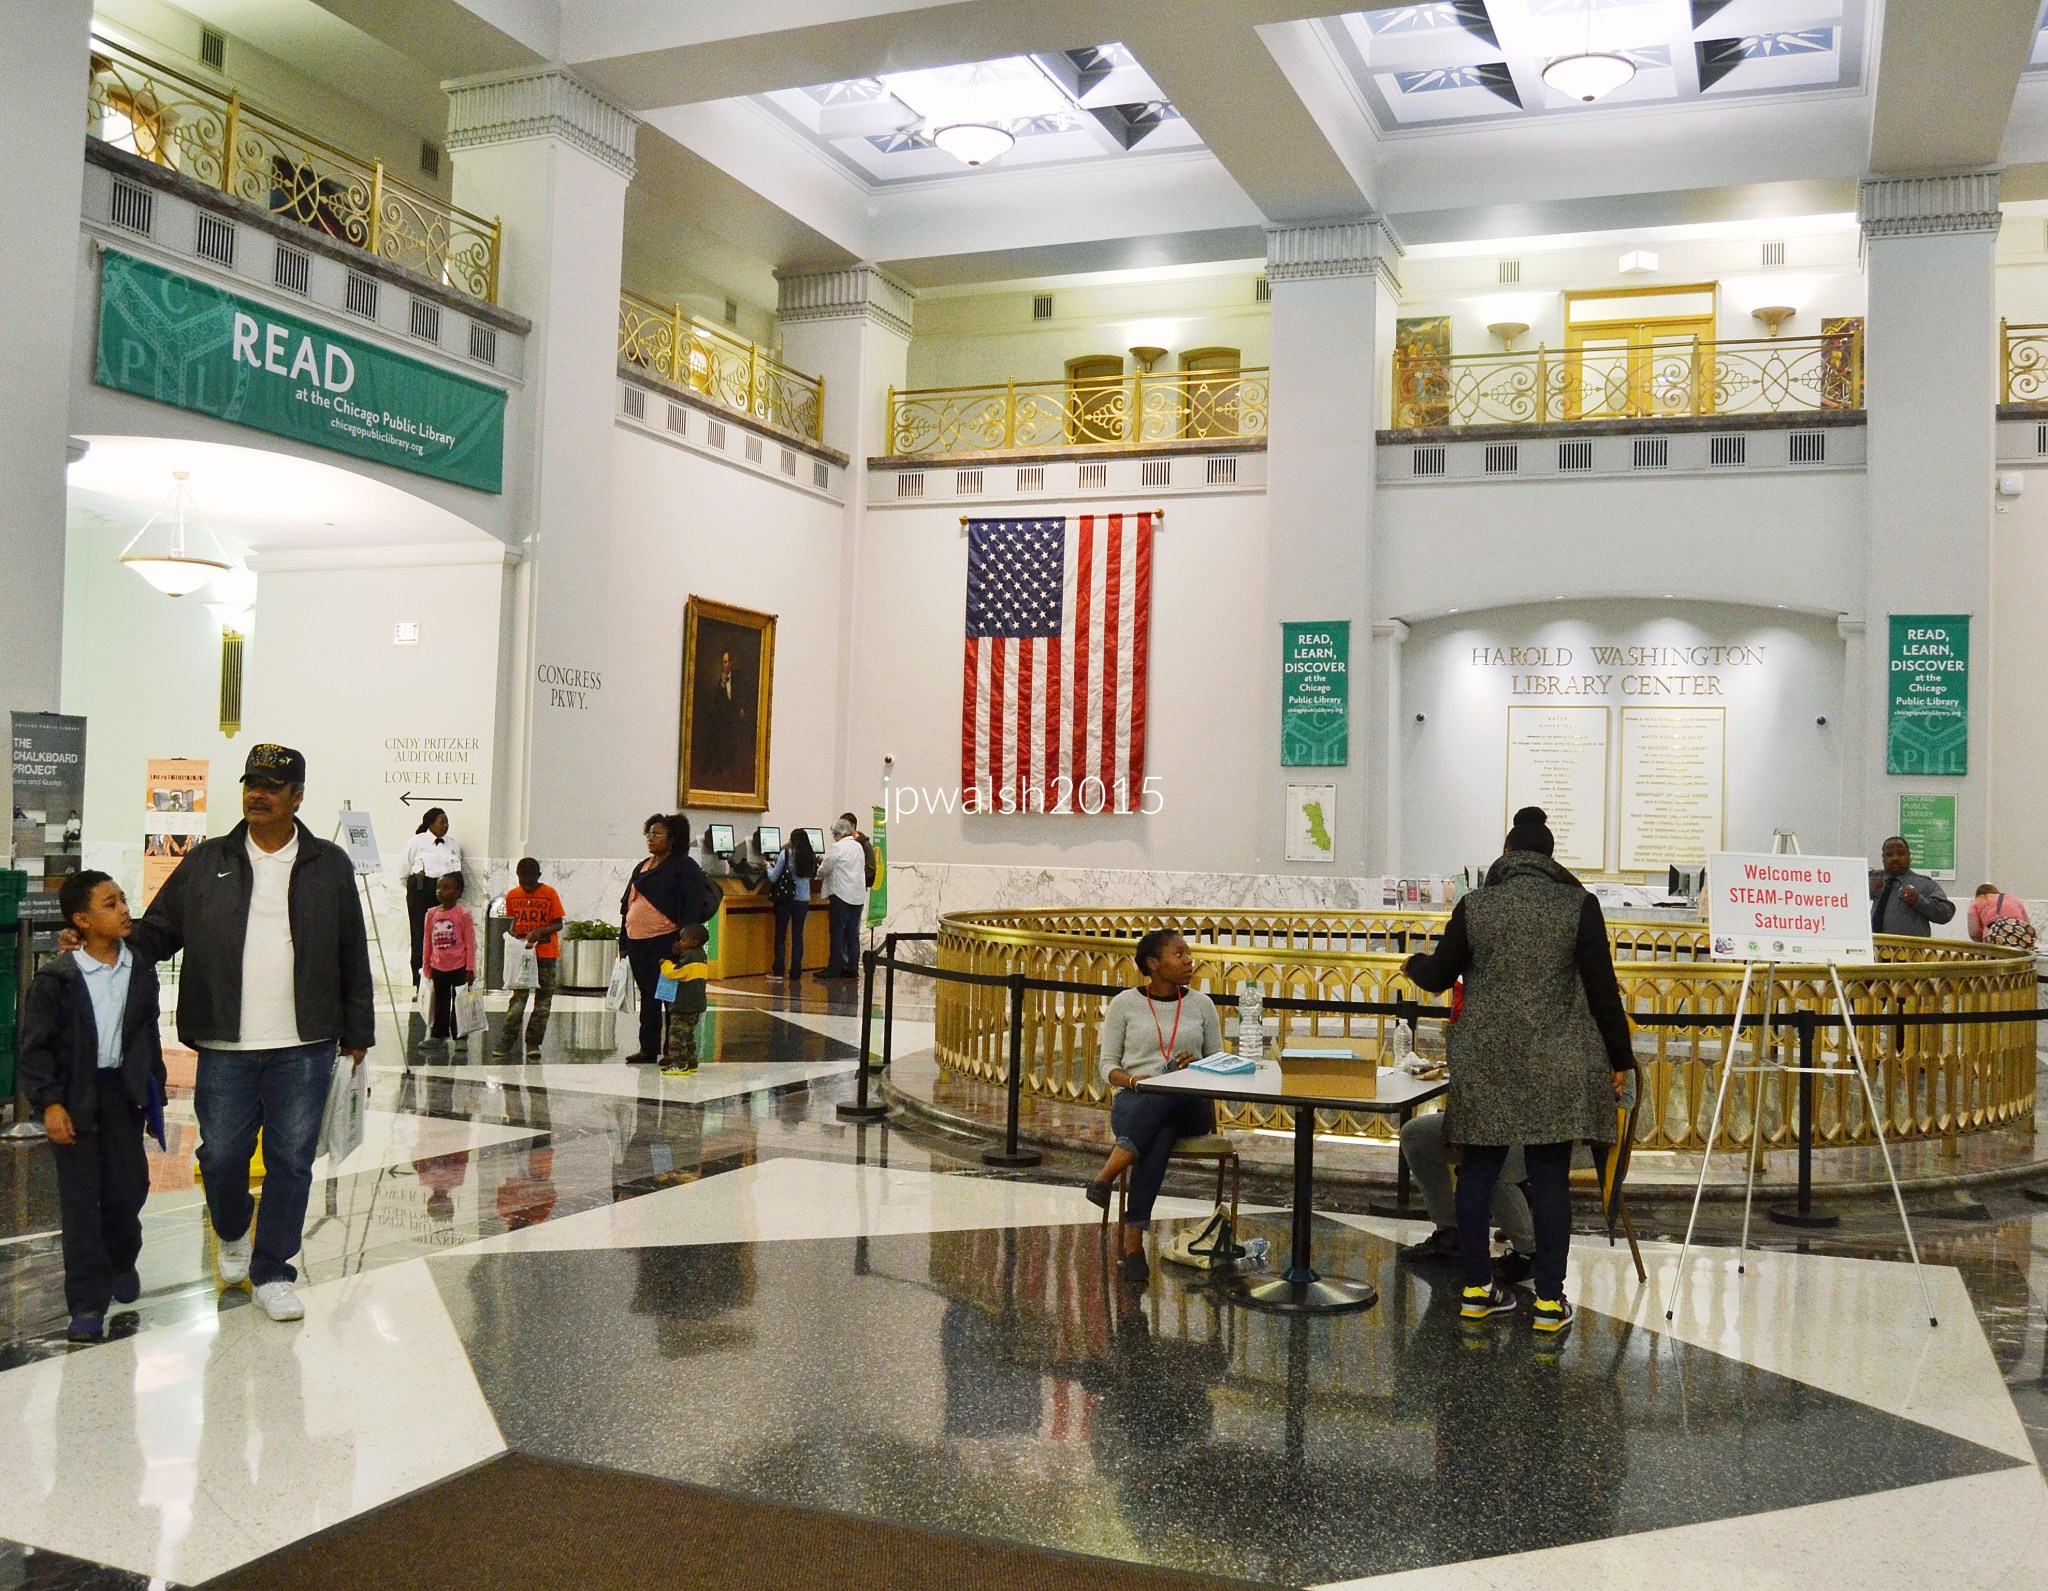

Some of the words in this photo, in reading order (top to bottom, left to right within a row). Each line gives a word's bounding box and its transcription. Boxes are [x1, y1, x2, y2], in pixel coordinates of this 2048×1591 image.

[232, 312, 355, 392] READ
[295, 388, 308, 402] at
[311, 391, 330, 409] the
[333, 397, 380, 426] Chicago
[383, 412, 417, 435] Public
[419, 423, 456, 450] Library
[331, 418, 424, 457] chicagopubliclibrary.org
[1298, 634, 1333, 646] READ,
[1907, 629, 1949, 642] READ,
[1294, 648, 1337, 660] LEARN,
[1471, 646, 1573, 667] HAROLD
[1591, 646, 1766, 667] WASHINGTON
[1903, 644, 1954, 657] LEARN,
[1285, 662, 1346, 673] DISCOVER
[1891, 660, 1965, 672] DISCOVER
[537, 664, 602, 690] CONGRESS
[1313, 674, 1327, 682] the
[1926, 674, 1942, 682] the
[1299, 684, 1331, 694] Chicago
[1511, 675, 1613, 695] LIBRARY
[1621, 675, 1724, 695] CENTER
[1909, 684, 1947, 695] Chicago
[551, 688, 589, 710] PKWY.
[1289, 695, 1313, 704] Public
[1314, 695, 1342, 706] Library
[1896, 697, 1925, 706] Public
[1927, 697, 1959, 707] Library
[13, 737, 32, 748] THE
[384, 738, 421, 750] CINDY
[424, 738, 480, 750] PRITZKER
[13, 750, 78, 764] CHALKBOARD
[394, 750, 469, 763] AUDITORIUM
[13, 763, 58, 775] PROJECT
[384, 771, 431, 784] LOWER
[436, 771, 479, 785] LEVEL
[1744, 864, 1812, 883] Welcome
[1816, 868, 1831, 884] to
[1729, 887, 1849, 909] STEAM-Powered
[513, 900, 548, 910] CHICAGO
[515, 910, 548, 923] PARK
[1754, 912, 1826, 934] Saturday!
